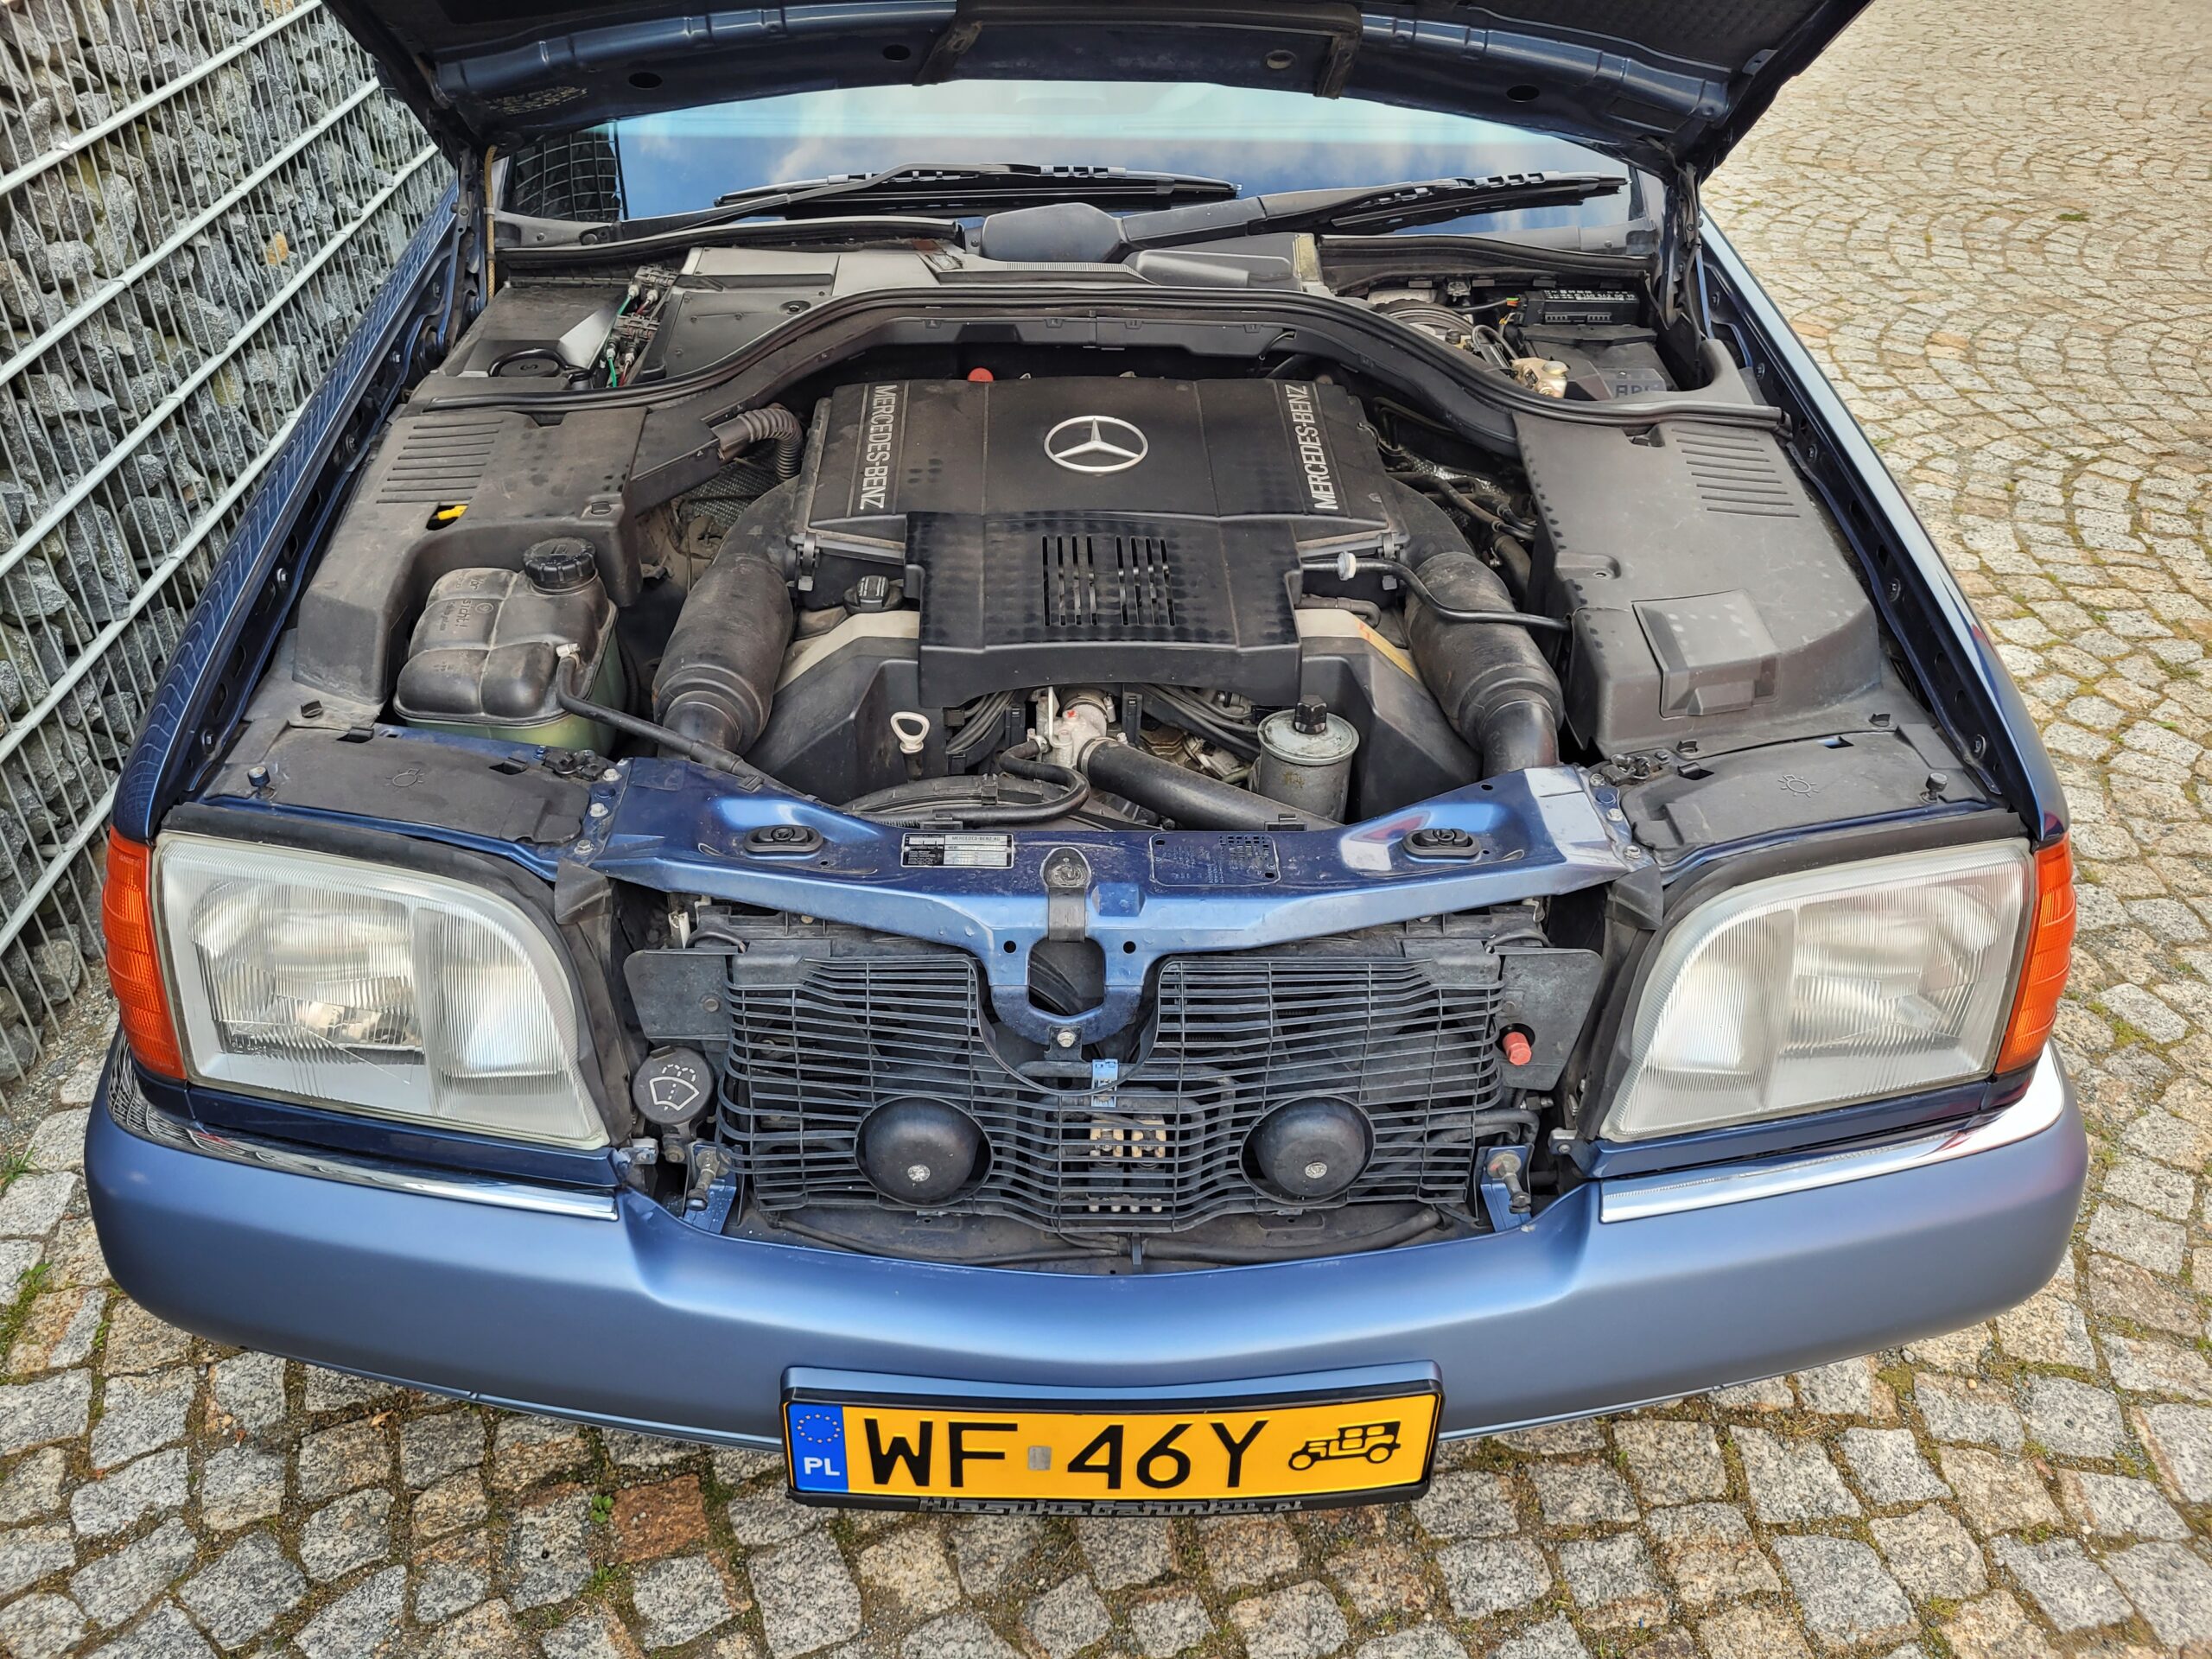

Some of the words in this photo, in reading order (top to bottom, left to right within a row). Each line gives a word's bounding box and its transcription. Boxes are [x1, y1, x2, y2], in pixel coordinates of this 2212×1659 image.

[860, 385, 898, 510] MERCEDES-BENZ
[1285, 384, 1339, 510] MERCEDES-BENZ
[804, 1457, 841, 1476] PL
[864, 1418, 1018, 1488] WF
[1067, 1420, 1269, 1490] 46Y
